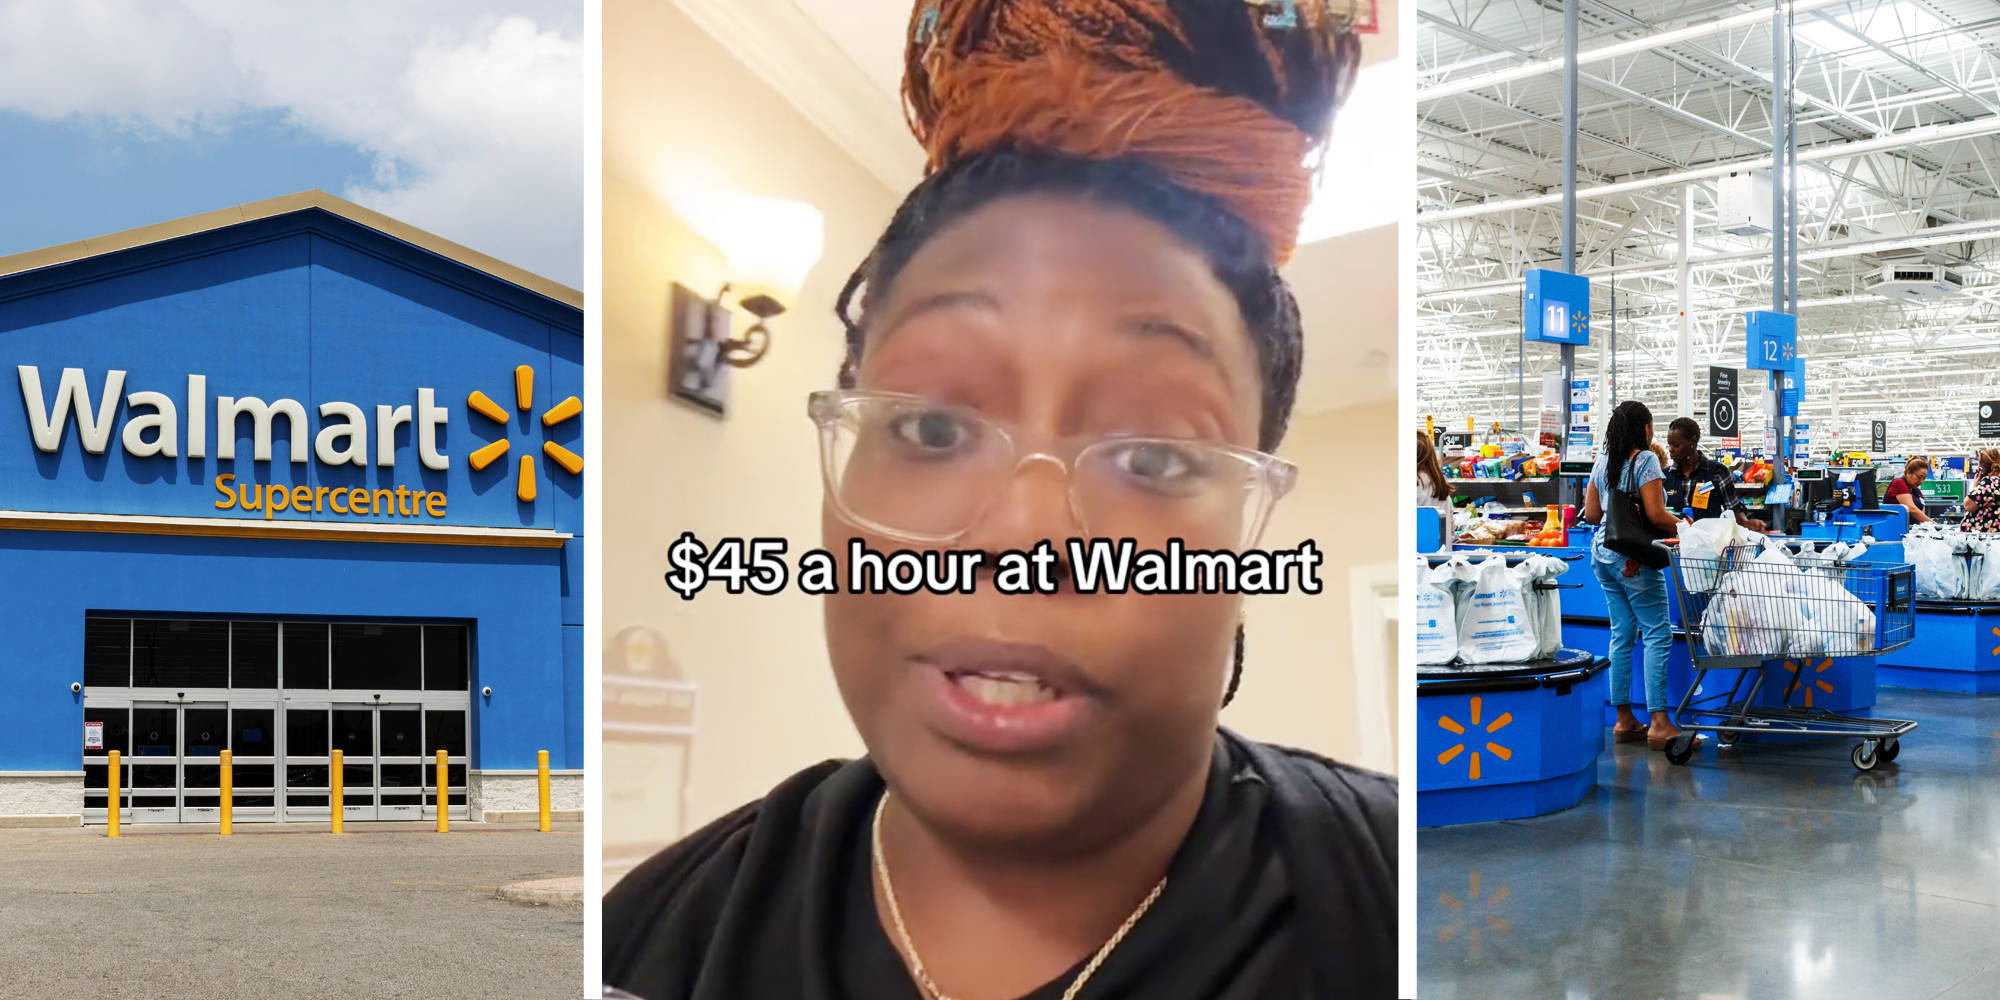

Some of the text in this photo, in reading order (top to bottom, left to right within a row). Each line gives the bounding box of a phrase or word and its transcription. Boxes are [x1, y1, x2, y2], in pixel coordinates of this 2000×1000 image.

[1547, 305, 1564, 332] 11
[1763, 340, 1778, 361] 12
[17, 364, 450, 470] Walmart
[214, 473, 448, 526] Supercentre
